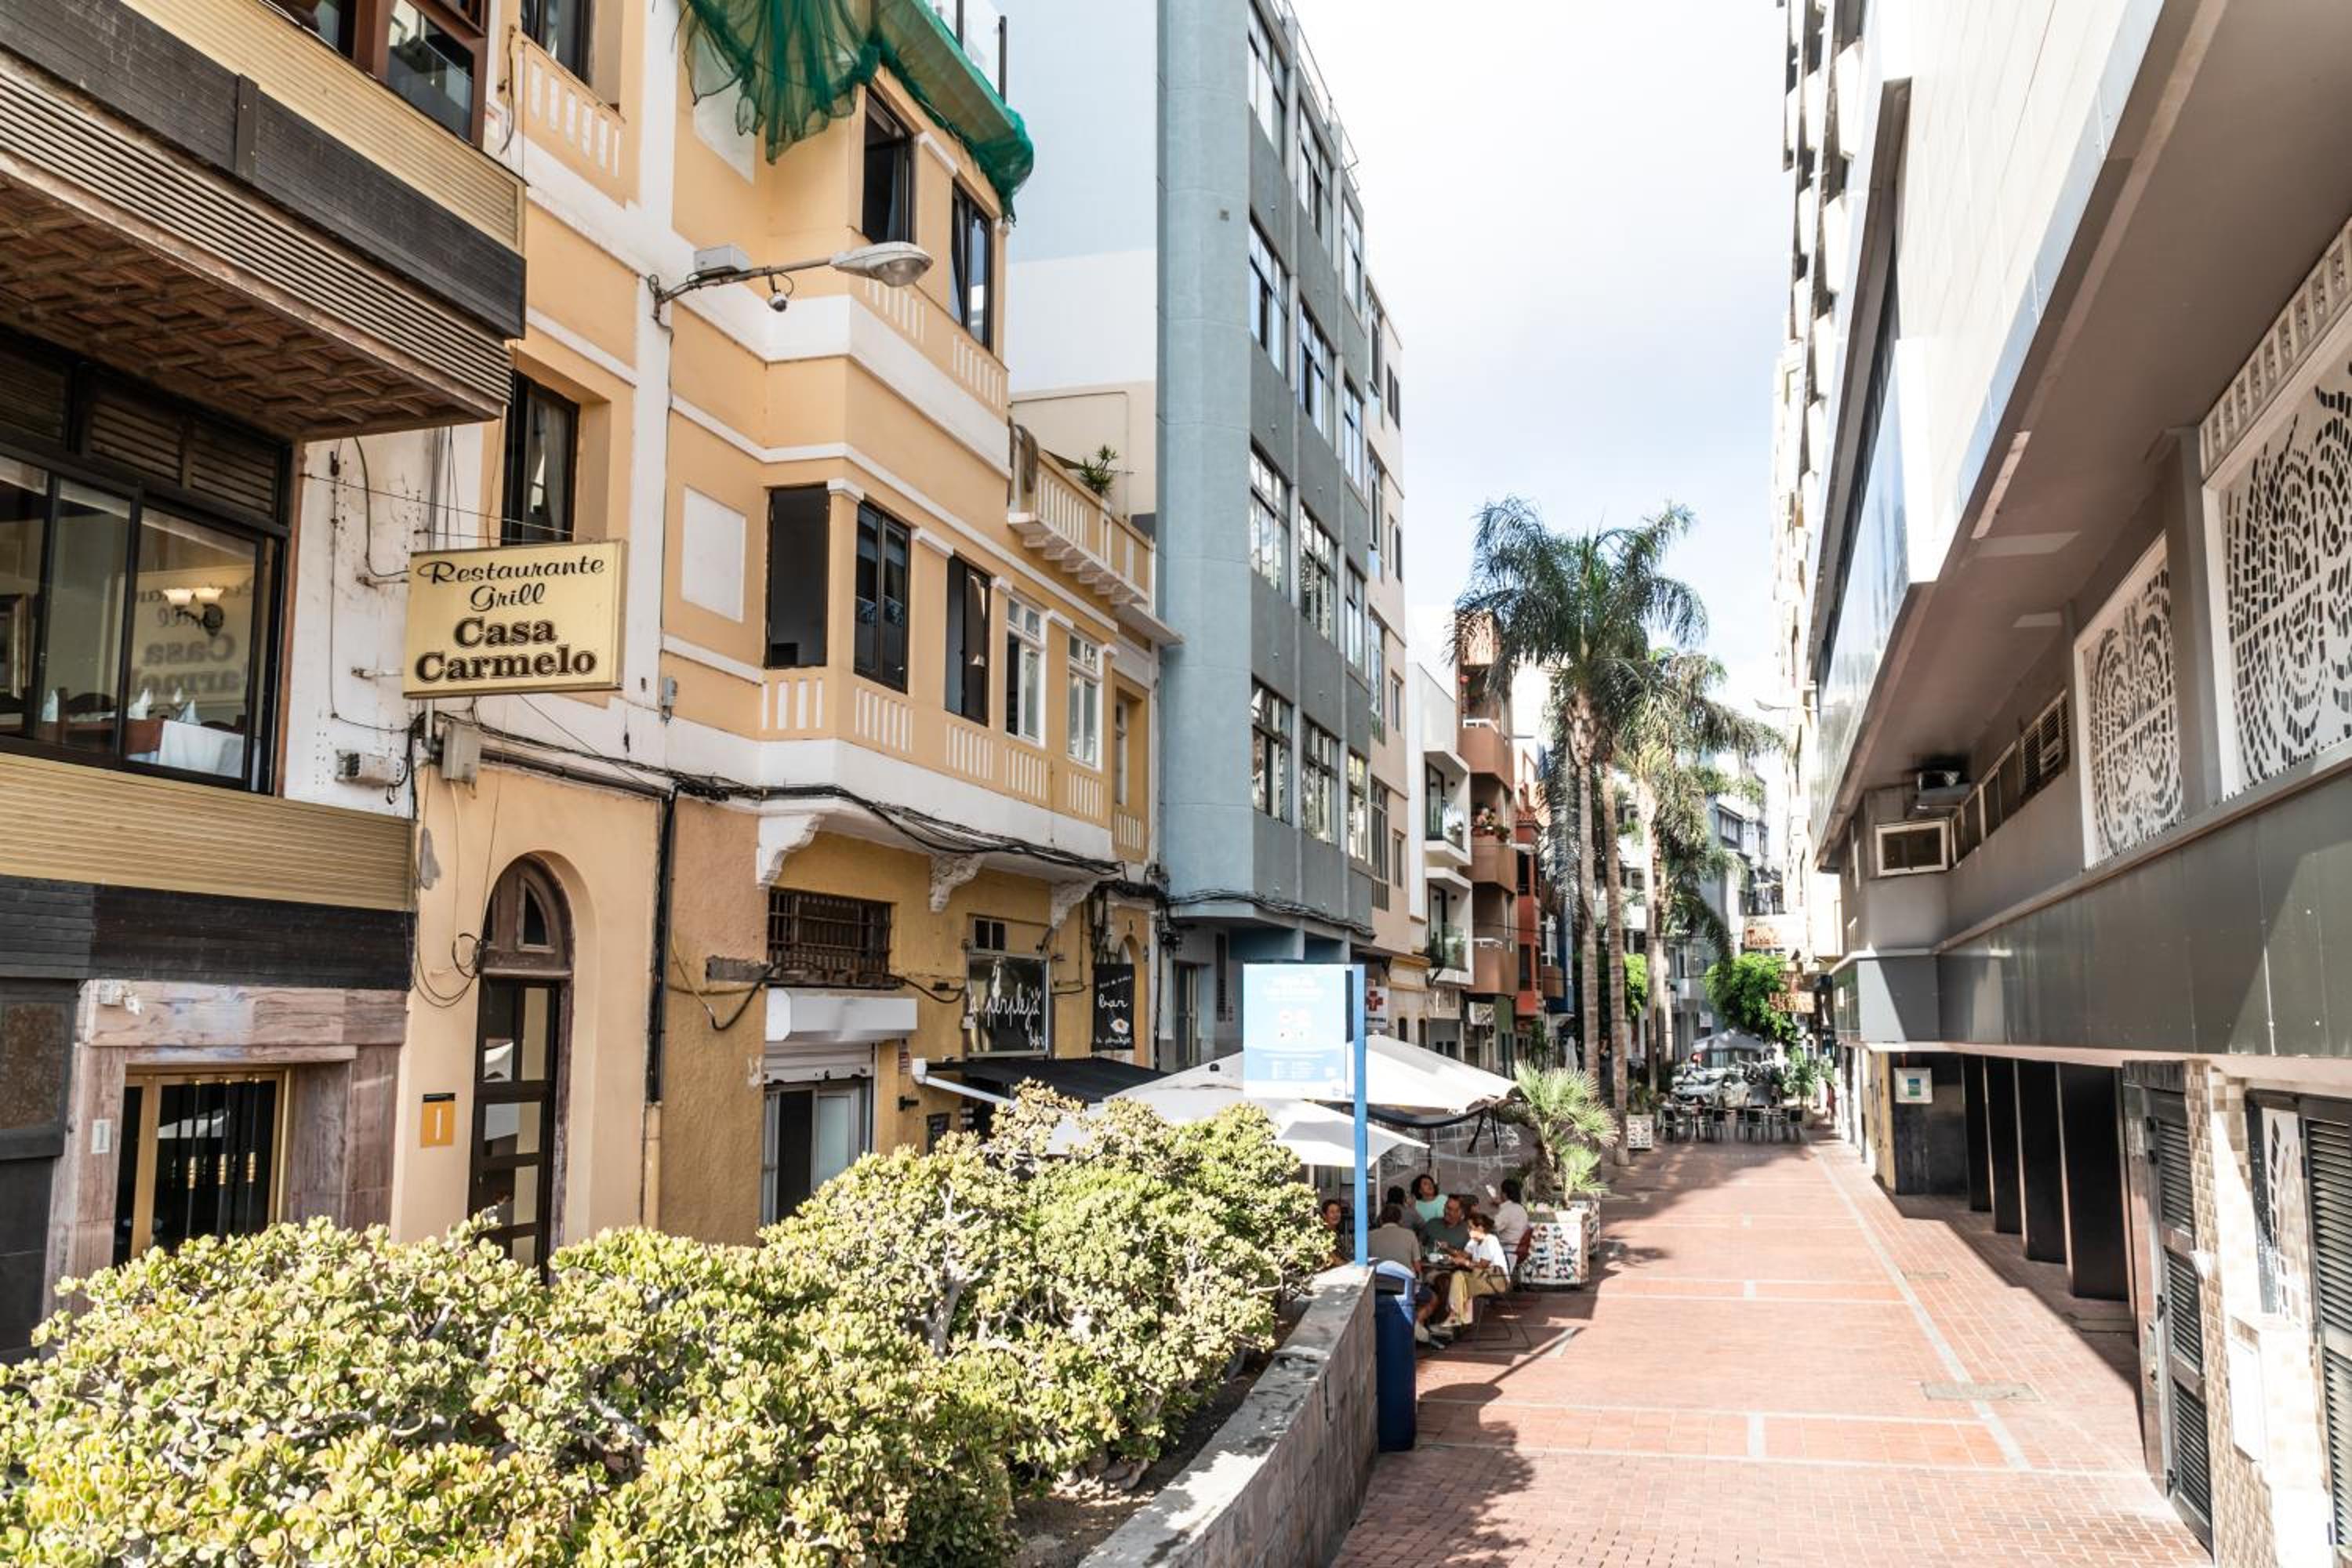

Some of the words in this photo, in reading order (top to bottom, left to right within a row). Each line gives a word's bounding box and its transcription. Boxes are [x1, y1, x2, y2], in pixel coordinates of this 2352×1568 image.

[417, 556, 604, 584] Restaurante
[470, 583, 545, 612] Grill
[454, 617, 557, 648] Casa
[415, 645, 597, 682] Carmelo
[1098, 993, 1128, 1007] bar
